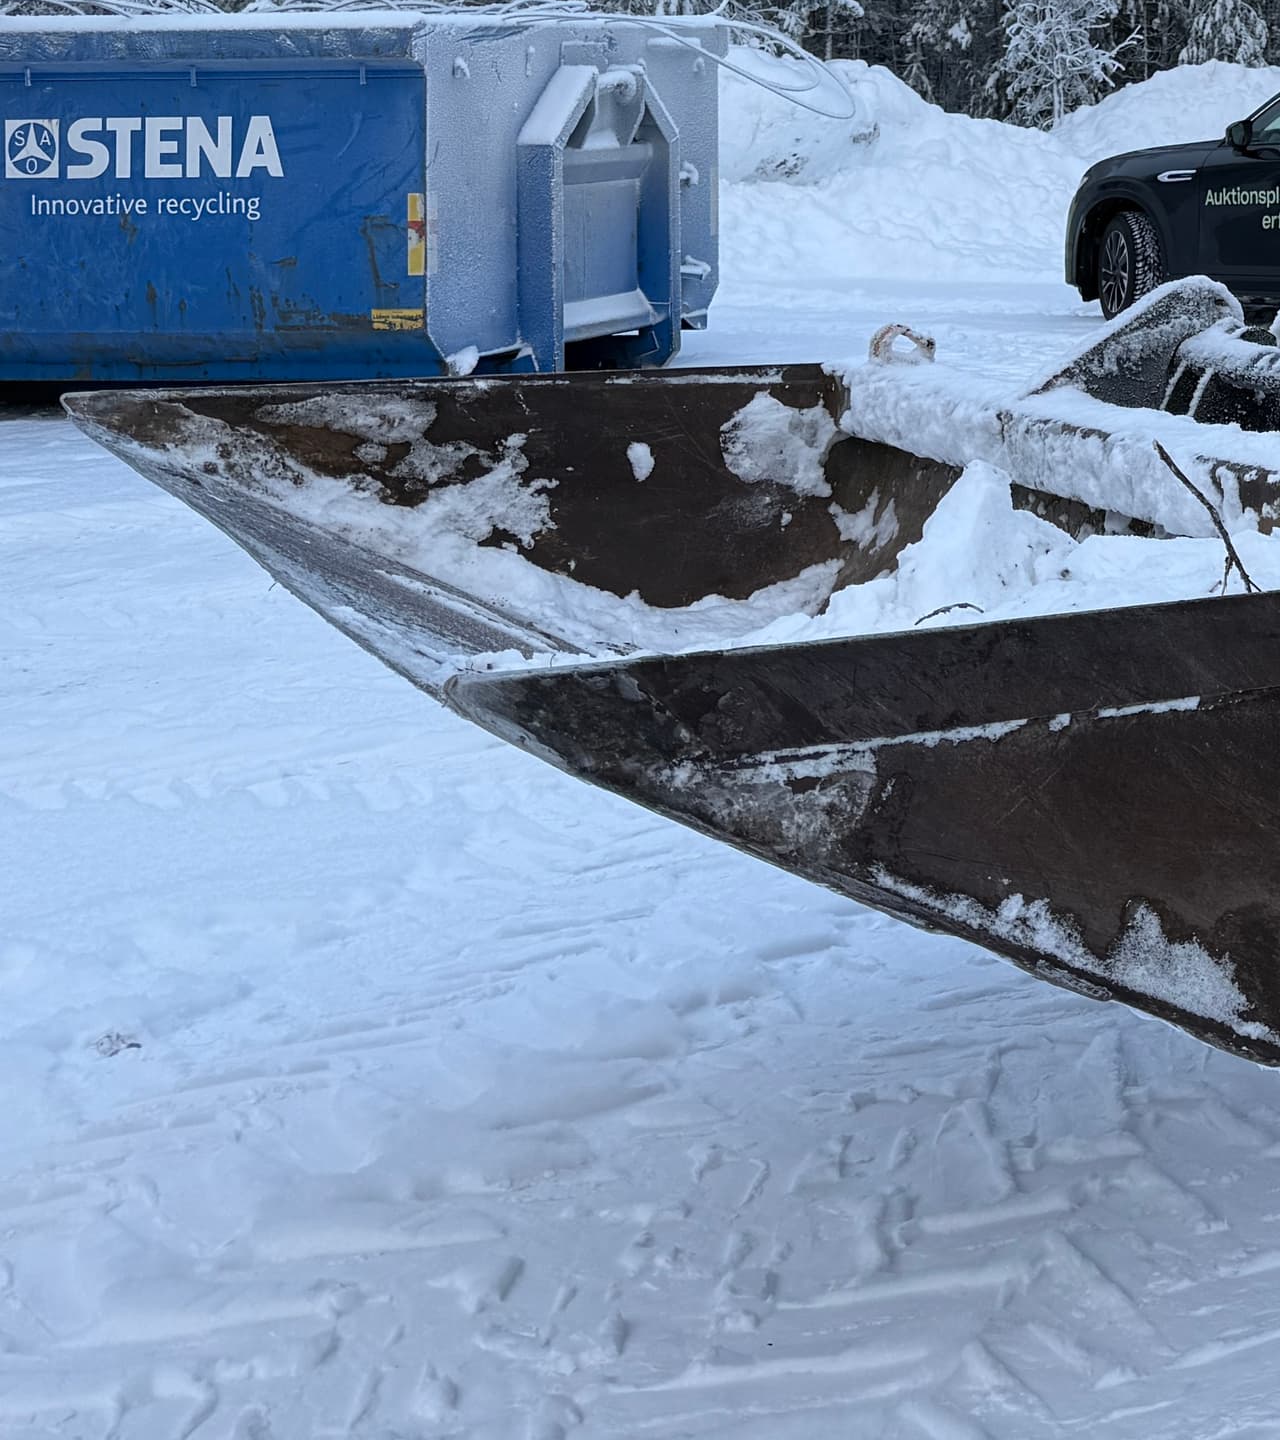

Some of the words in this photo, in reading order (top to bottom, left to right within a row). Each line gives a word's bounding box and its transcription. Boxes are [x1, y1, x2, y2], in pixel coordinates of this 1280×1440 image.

[66, 115, 284, 179] STENA
[31, 193, 148, 217] Innovative
[157, 192, 261, 221] recycling
